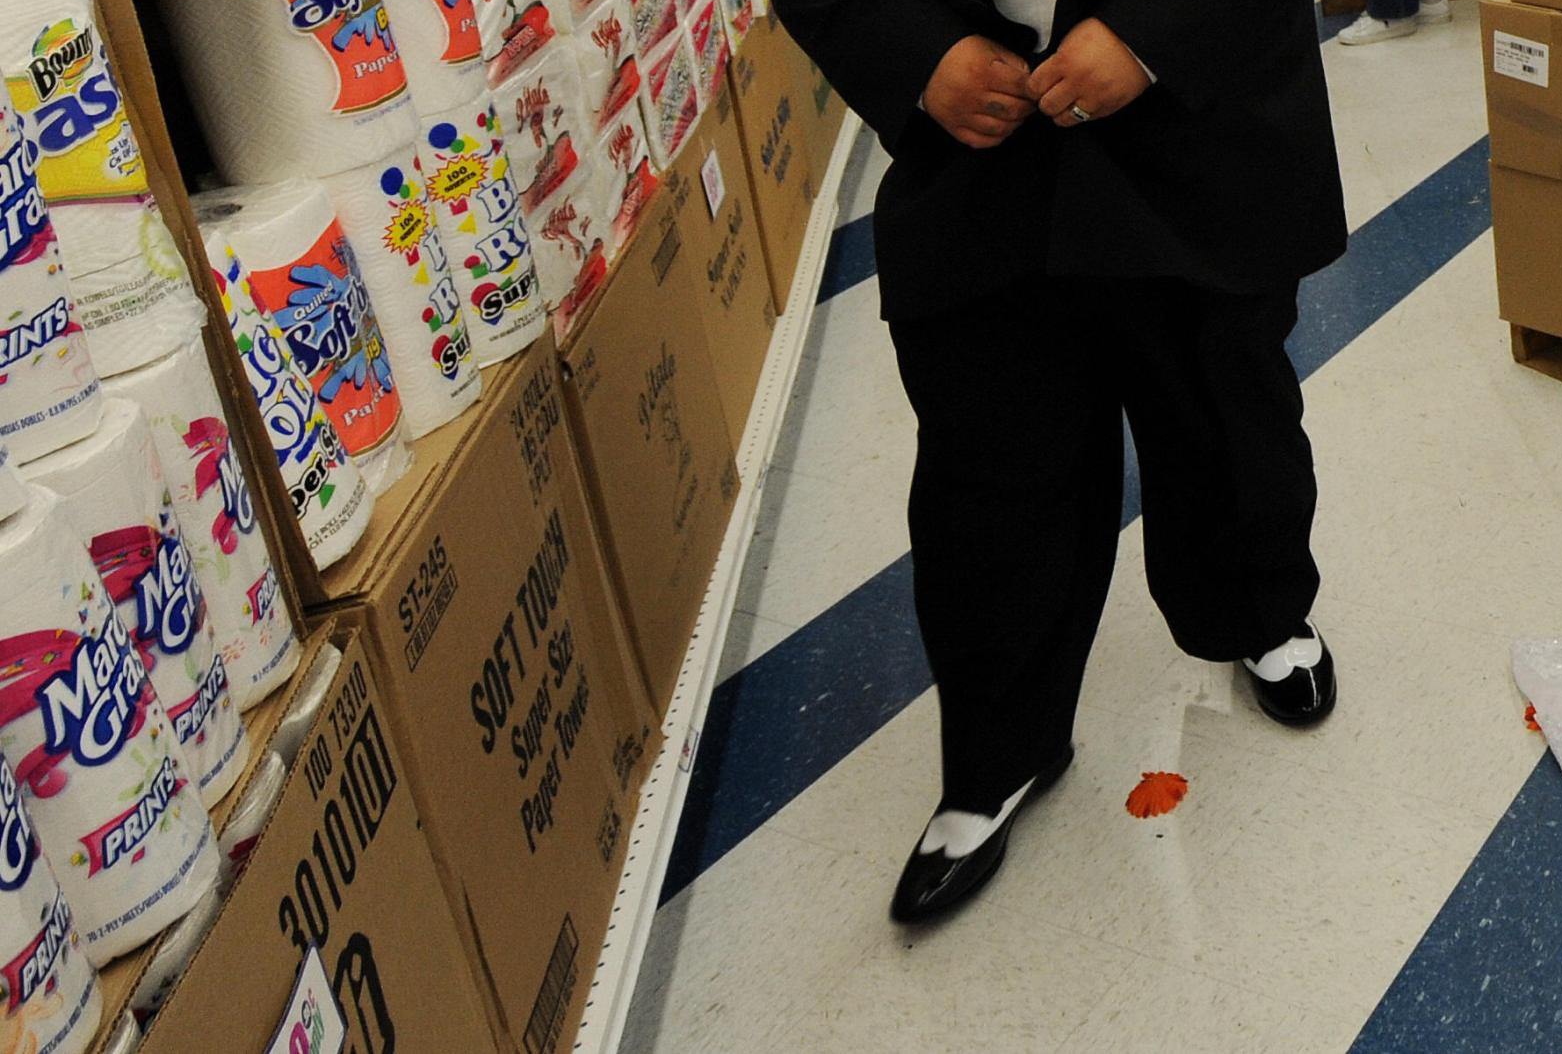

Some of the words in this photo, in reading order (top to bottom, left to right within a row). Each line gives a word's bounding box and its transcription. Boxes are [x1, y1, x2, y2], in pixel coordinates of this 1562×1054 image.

[354, 51, 399, 79] Paper
[399, 212, 416, 231] 100
[447, 166, 469, 182] 100
[293, 281, 334, 321] Quilted
[398, 533, 448, 634] ST-245
[470, 608, 526, 754] SOFT
[515, 507, 571, 646] TOUCH
[304, 733, 333, 802] 100
[328, 660, 368, 751] 73310
[510, 680, 557, 780] Super
[103, 757, 177, 869] PRINTS
[520, 746, 563, 855] Paper
